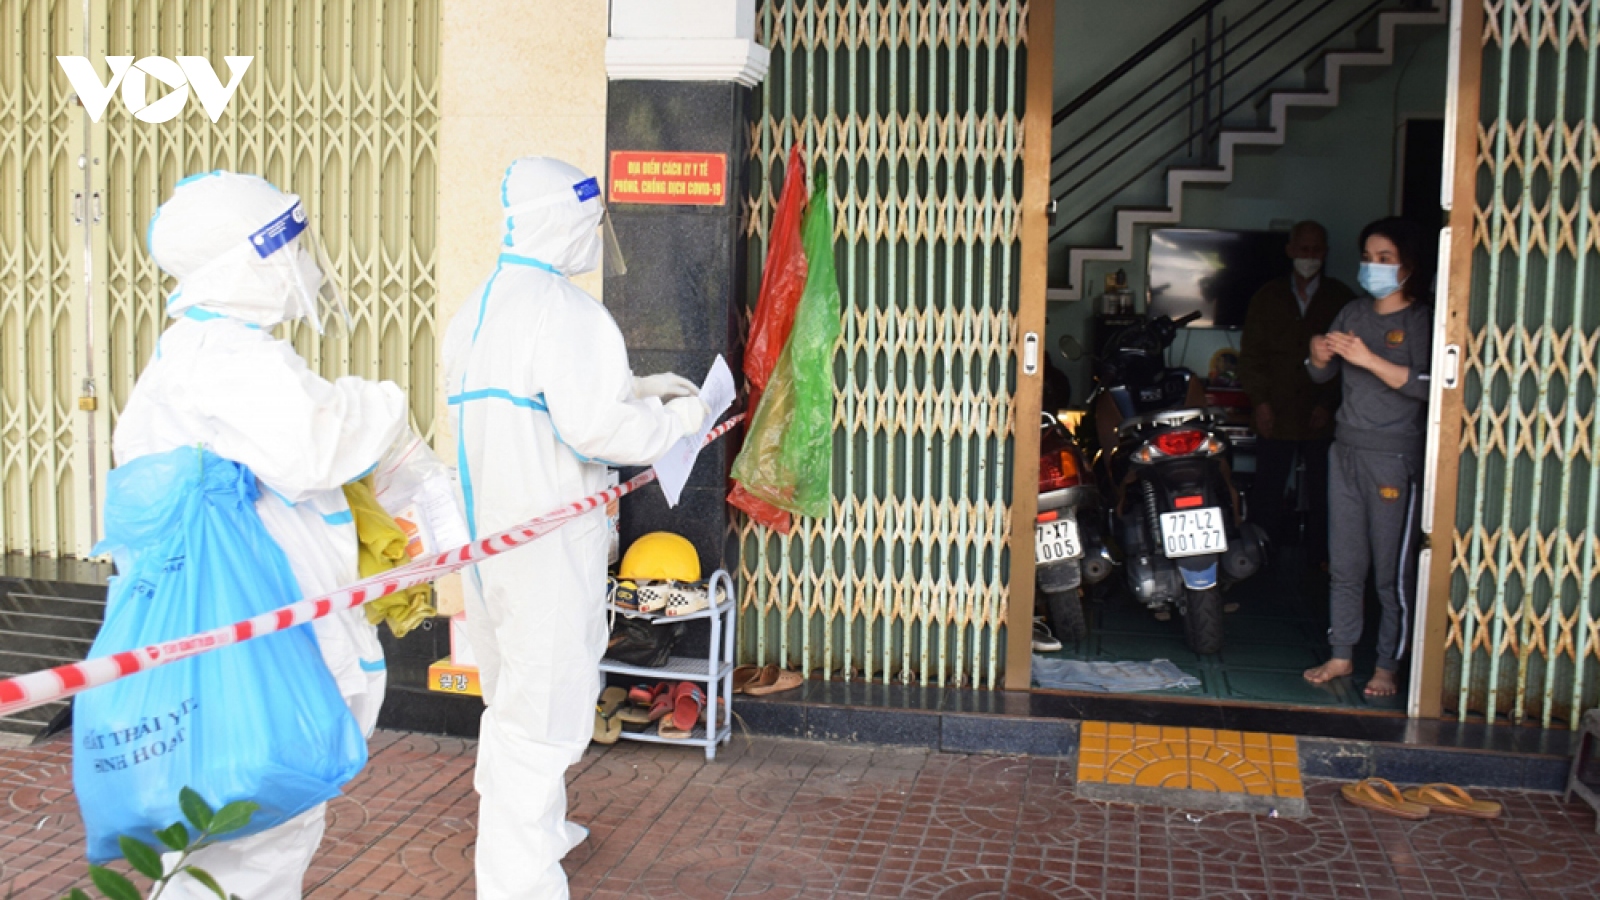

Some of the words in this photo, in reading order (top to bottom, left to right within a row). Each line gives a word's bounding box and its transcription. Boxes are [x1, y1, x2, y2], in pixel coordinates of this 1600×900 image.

[687, 181, 721, 196] COVID-19
[1169, 511, 1213, 533] 77-L2
[1035, 539, 1074, 562] 005
